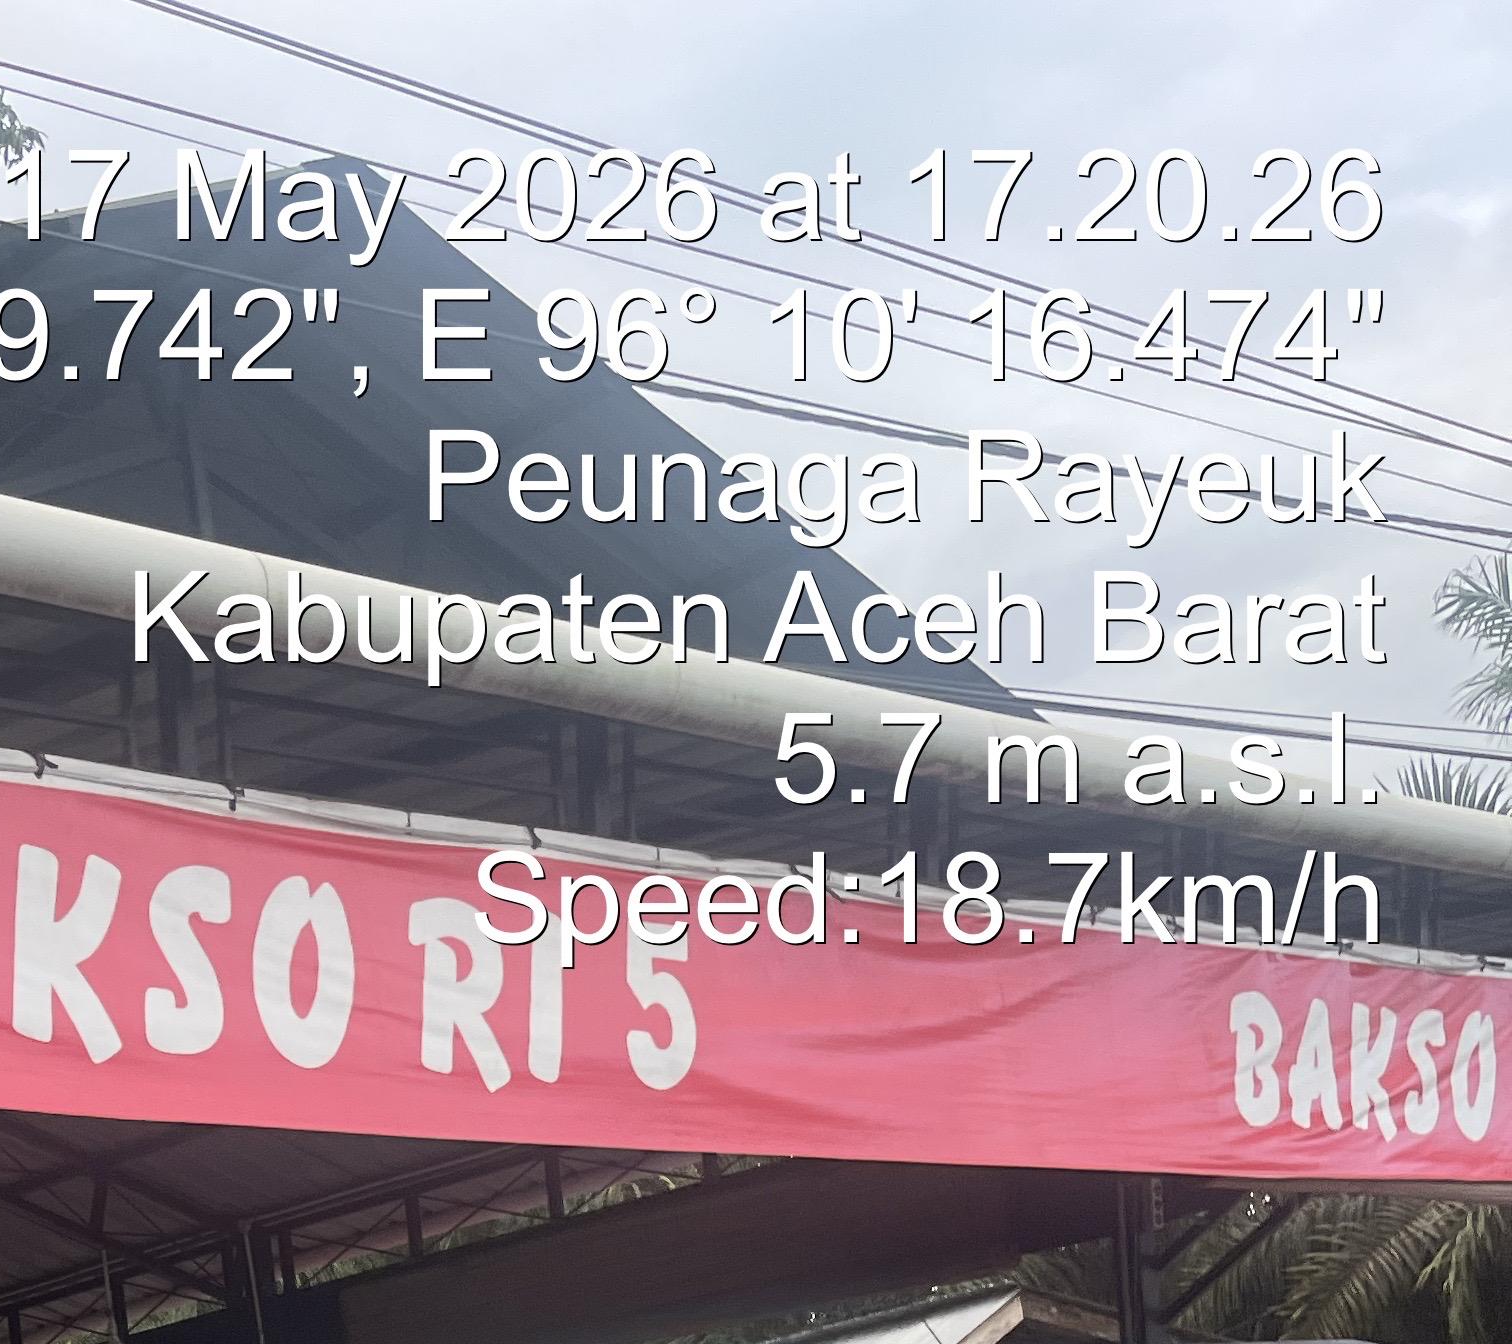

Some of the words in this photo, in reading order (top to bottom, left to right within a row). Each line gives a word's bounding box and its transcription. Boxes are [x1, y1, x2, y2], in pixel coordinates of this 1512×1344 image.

[408, 897, 563, 1093] RI
[626, 918, 697, 1090] 5
[1229, 990, 1497, 1143] BAKSO
